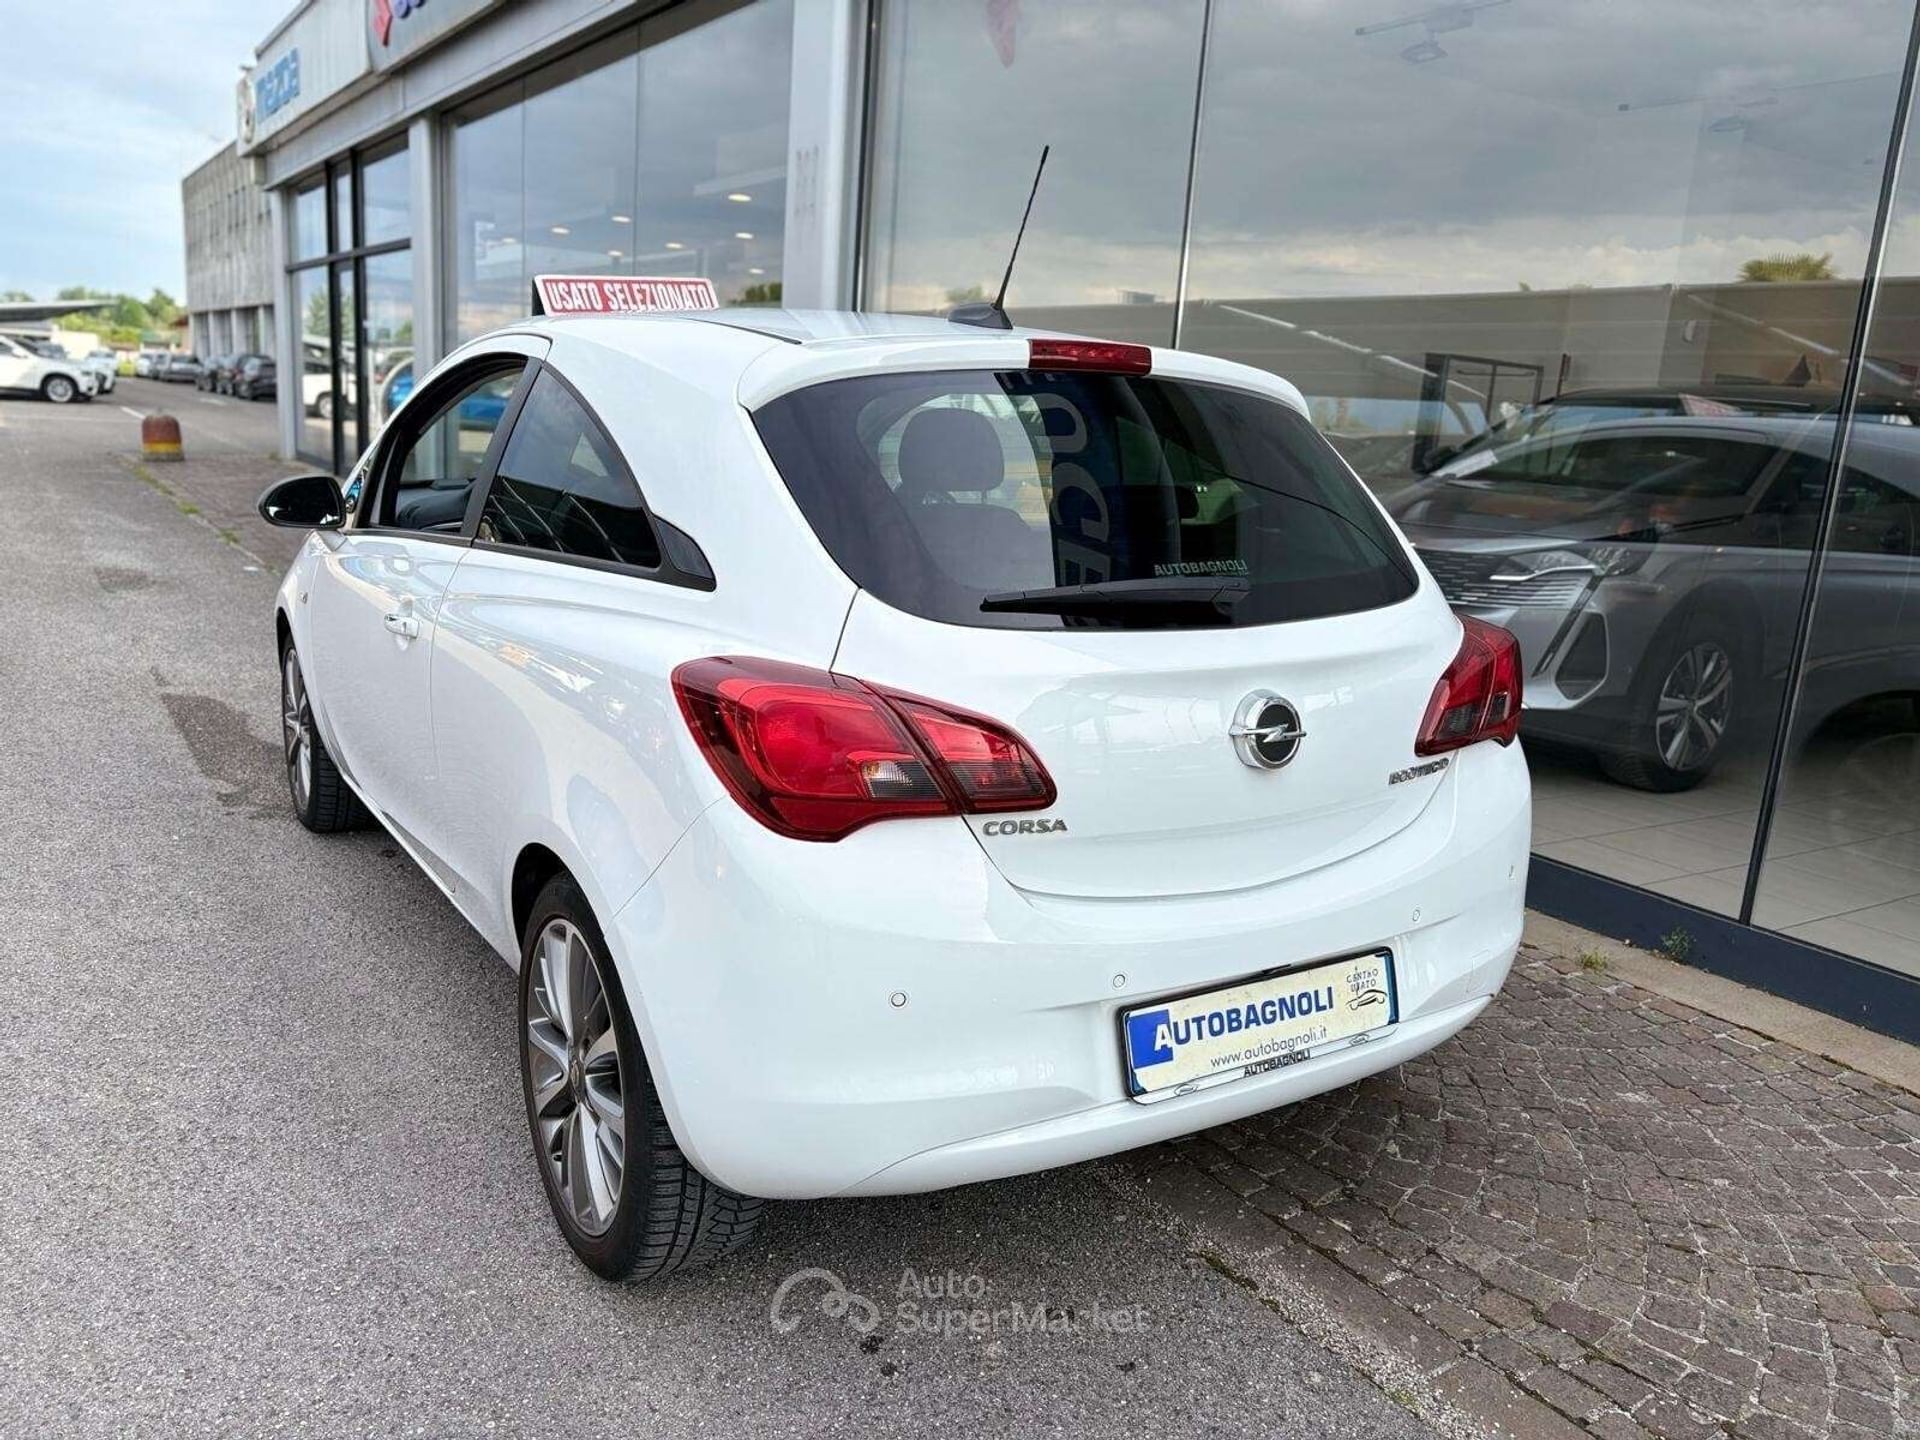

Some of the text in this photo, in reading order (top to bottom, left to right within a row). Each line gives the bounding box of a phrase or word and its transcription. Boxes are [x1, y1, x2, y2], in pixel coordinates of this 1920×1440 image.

[546, 281, 712, 312] USATO SELEZIONATO
[1154, 560, 1248, 576] AUTOBAGNOLI
[983, 819, 1067, 836] CORSA
[1153, 986, 1334, 1051] AUTOBAGNOLI
[1210, 1027, 1328, 1067] www.autobagnoli.it
[1243, 1049, 1311, 1077] AUTOBAGNOLI
